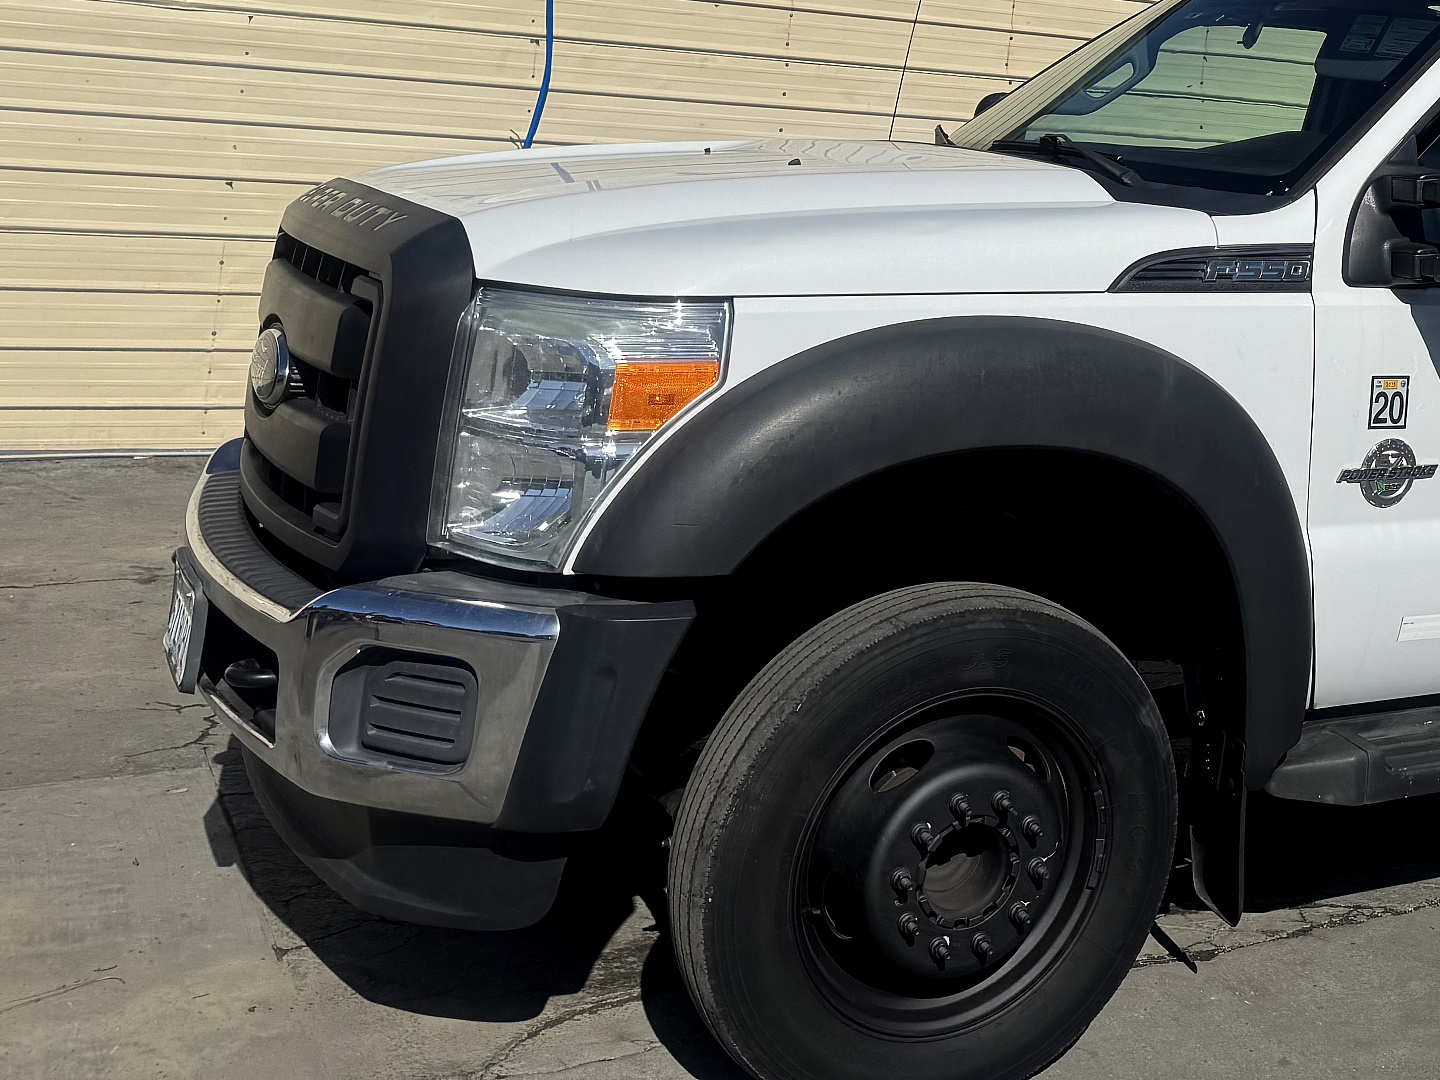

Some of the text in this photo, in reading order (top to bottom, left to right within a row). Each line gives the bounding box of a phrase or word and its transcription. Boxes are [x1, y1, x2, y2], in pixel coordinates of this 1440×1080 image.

[330, 197, 408, 231] DUTY
[1372, 390, 1405, 425] 20
[1340, 463, 1438, 481] POWER STROKE
